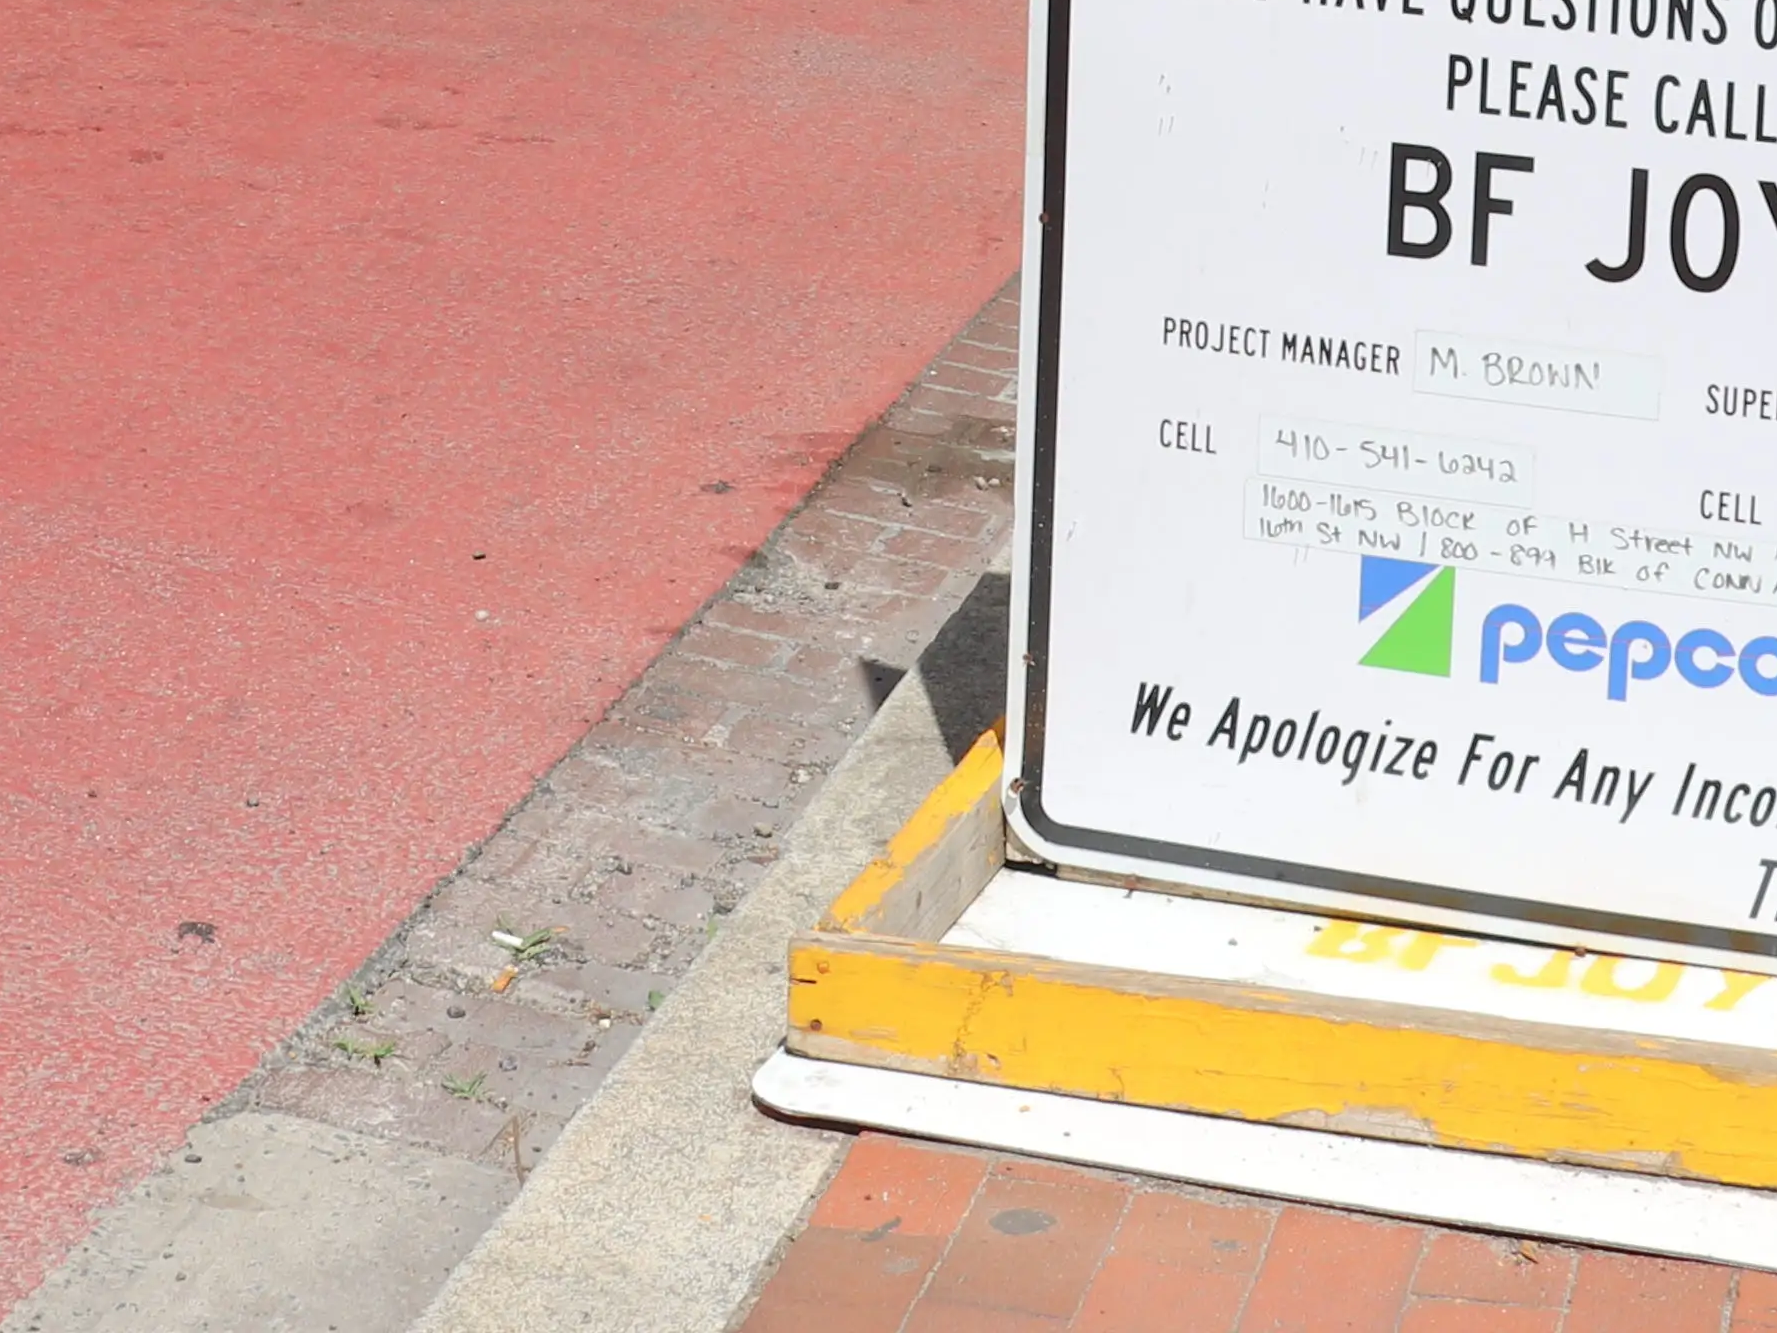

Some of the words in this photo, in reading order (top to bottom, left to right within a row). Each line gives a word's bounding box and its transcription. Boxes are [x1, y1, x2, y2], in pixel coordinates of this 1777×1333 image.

[1446, 53, 1630, 129] PLEASE
[1655, 74, 1777, 144] CALL
[1386, 142, 1535, 267] BF
[1163, 317, 1271, 358] PROJECT
[1282, 332, 1400, 375] MANAGER
[1430, 346, 1468, 381] M.
[1481, 353, 1599, 389] BROWN
[1160, 419, 1216, 454] CELL
[1276, 430, 1517, 483] 410-541-6242
[1700, 490, 1761, 525] CELL
[1317, 522, 1341, 545] St
[1358, 531, 1401, 551] NW
[1569, 522, 1589, 543] H
[1130, 682, 1191, 741] We
[1206, 696, 1438, 786] Apologize
[1458, 733, 1540, 793] For
[1552, 748, 1655, 824] Any
